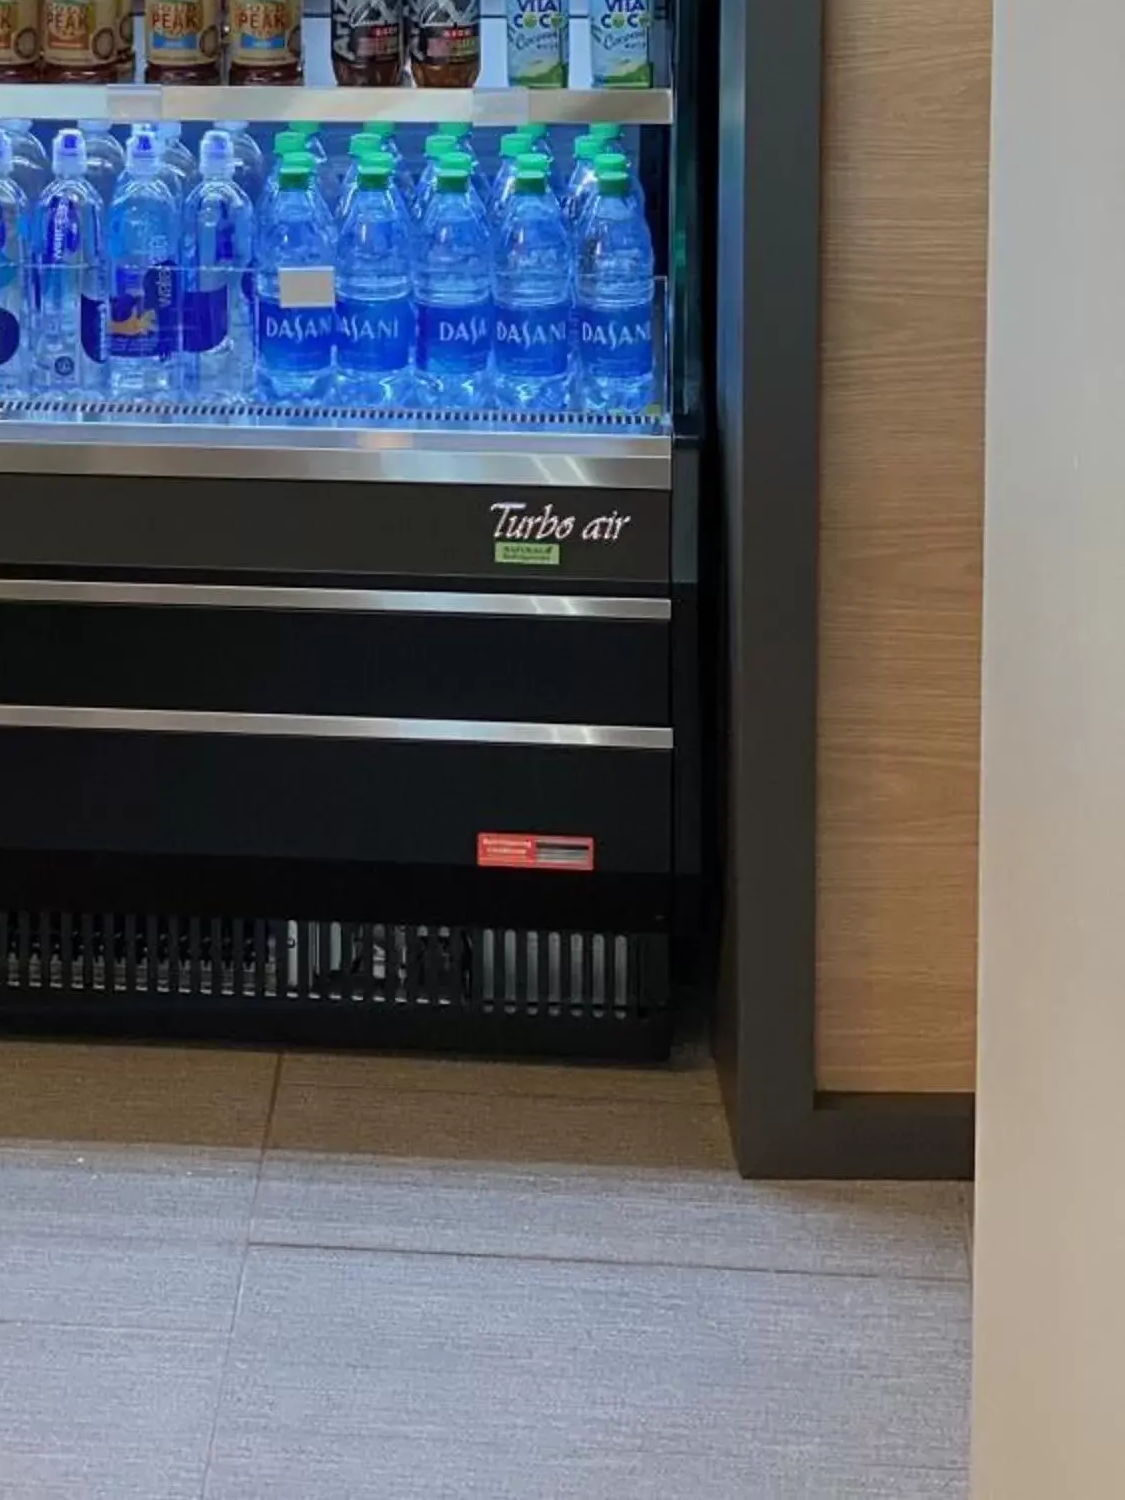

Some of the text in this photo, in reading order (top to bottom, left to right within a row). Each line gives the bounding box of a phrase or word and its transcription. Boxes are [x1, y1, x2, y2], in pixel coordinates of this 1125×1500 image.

[152, 11, 199, 30] PEAK
[237, 11, 285, 30] PEAK
[490, 502, 631, 540] Turbo air
